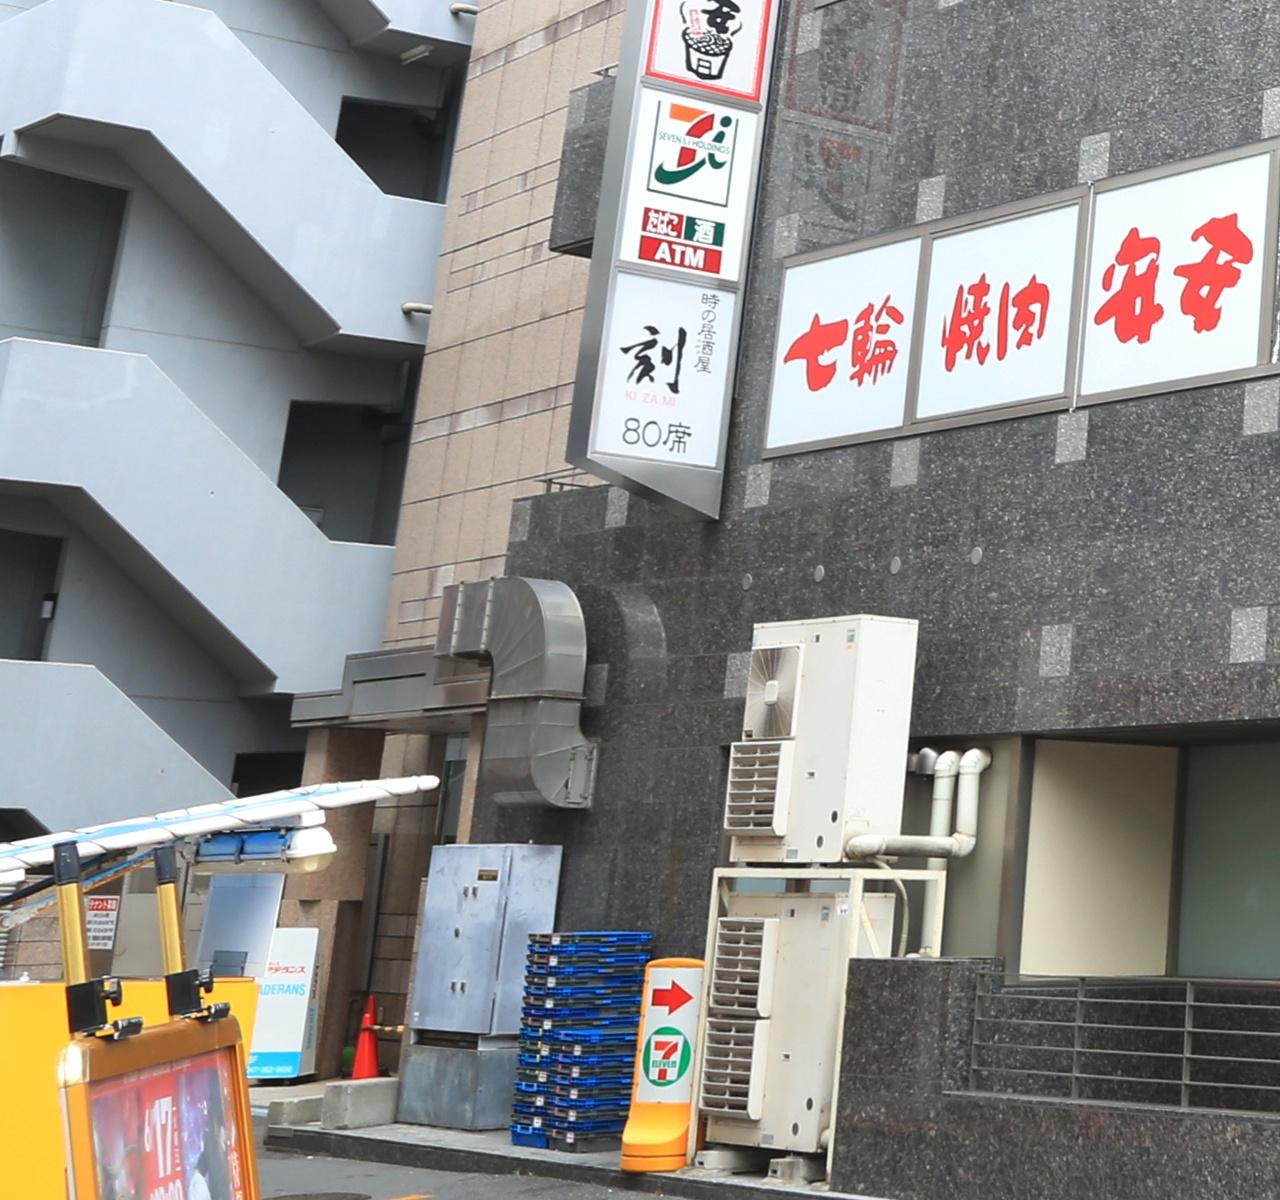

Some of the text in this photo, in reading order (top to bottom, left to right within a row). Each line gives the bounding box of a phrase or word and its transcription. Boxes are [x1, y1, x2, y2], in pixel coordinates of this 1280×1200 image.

[645, 208, 680, 238] たばこ
[694, 219, 718, 246] 酒
[652, 241, 706, 269] ATM
[692, 292, 721, 376] 時の居酒屋
[782, 292, 906, 393] 七輪
[941, 272, 1051, 373] 焼肉
[618, 323, 687, 395] 刻
[621, 416, 694, 455] 80席
